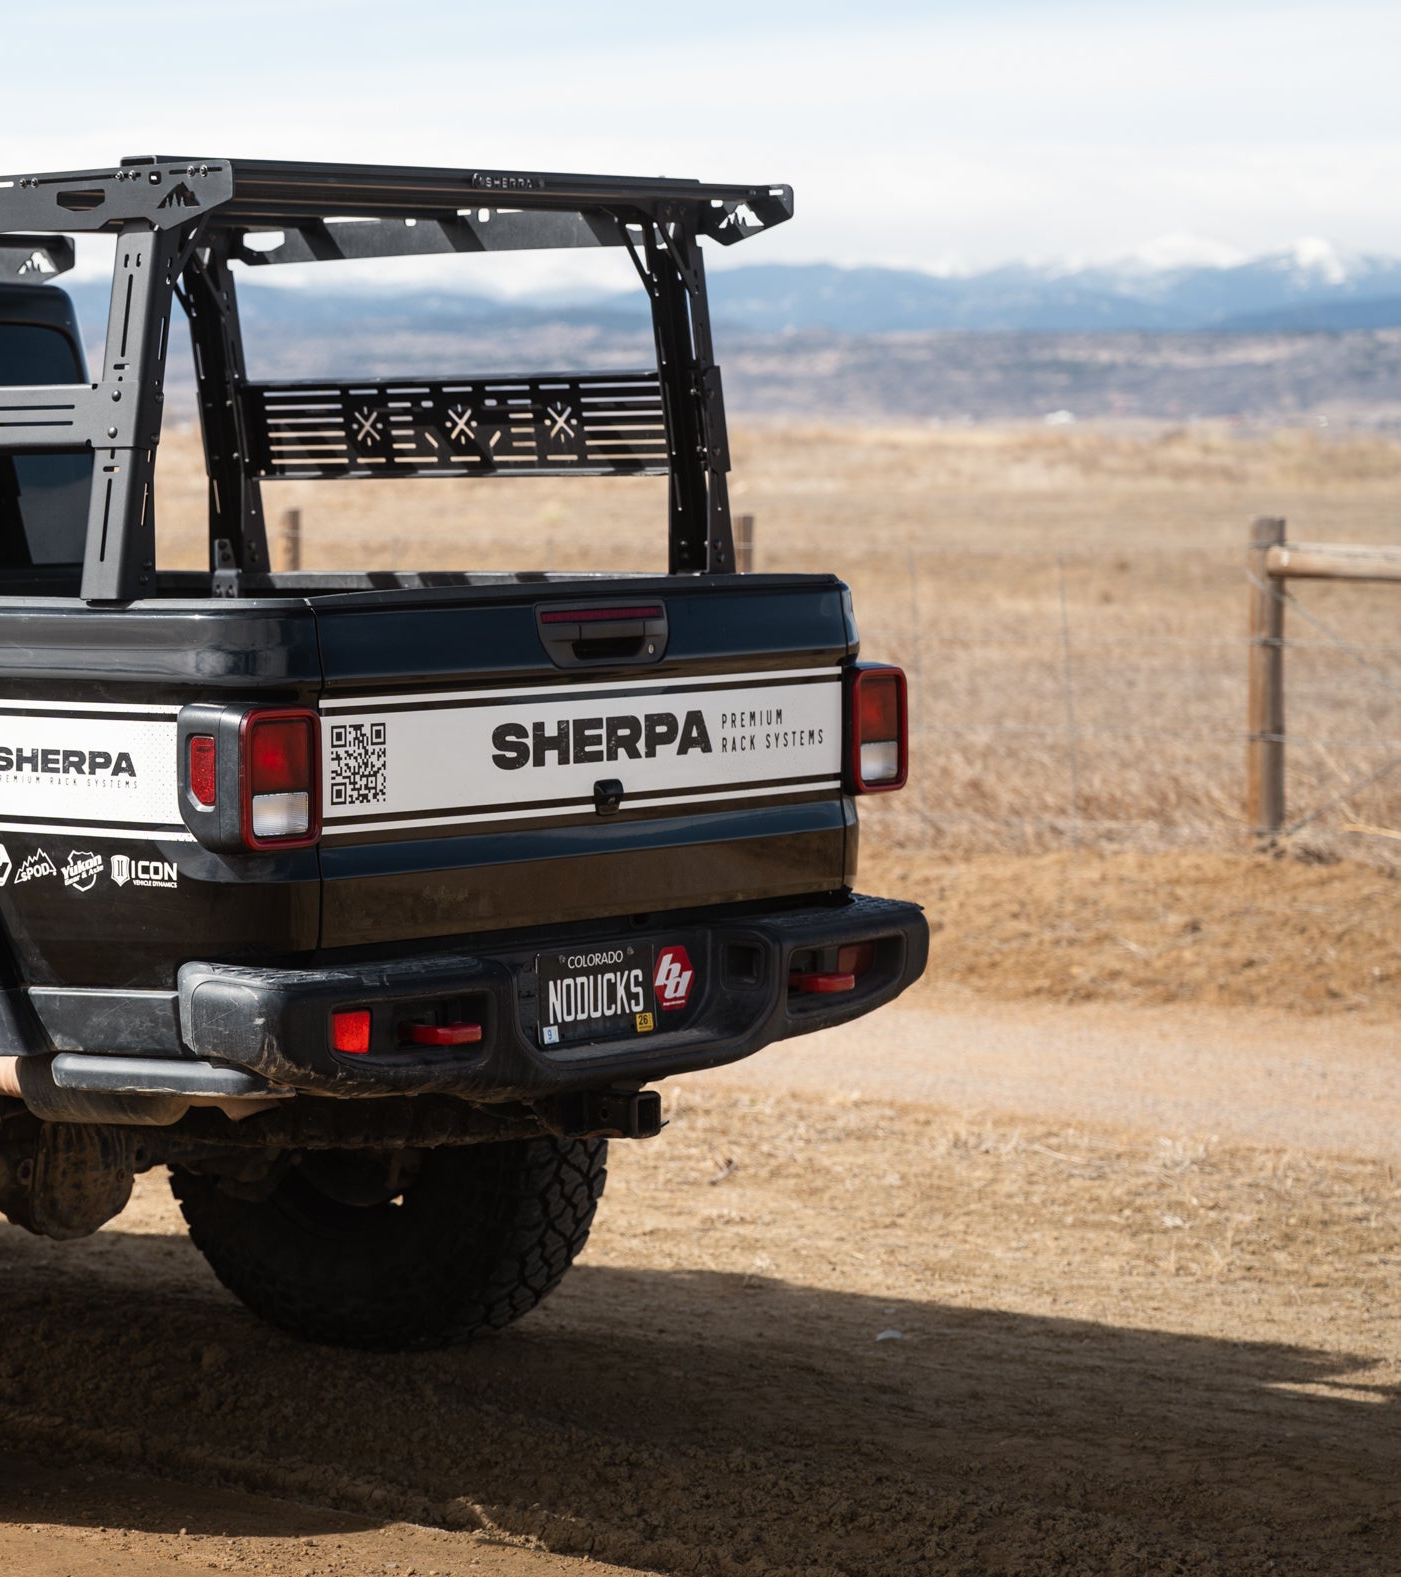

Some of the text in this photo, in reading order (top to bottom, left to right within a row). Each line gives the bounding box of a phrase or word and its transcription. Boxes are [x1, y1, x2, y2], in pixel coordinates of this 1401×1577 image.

[721, 708, 782, 729] PREMIUM
[491, 709, 713, 770] SHERPA
[721, 728, 823, 753] RACK SYSTEMS
[49, 777, 78, 786] RACK
[87, 778, 137, 789] SYSTEMS
[61, 854, 102, 879] Yukon
[130, 860, 177, 881] ICON
[64, 874, 80, 886] Gear
[133, 879, 177, 889] VEHICLE DYNAMICS
[567, 950, 623, 969] COLORADO
[548, 968, 644, 1025] NODUCKS
[638, 1014, 648, 1026] 26
[547, 1029, 554, 1041] 9
